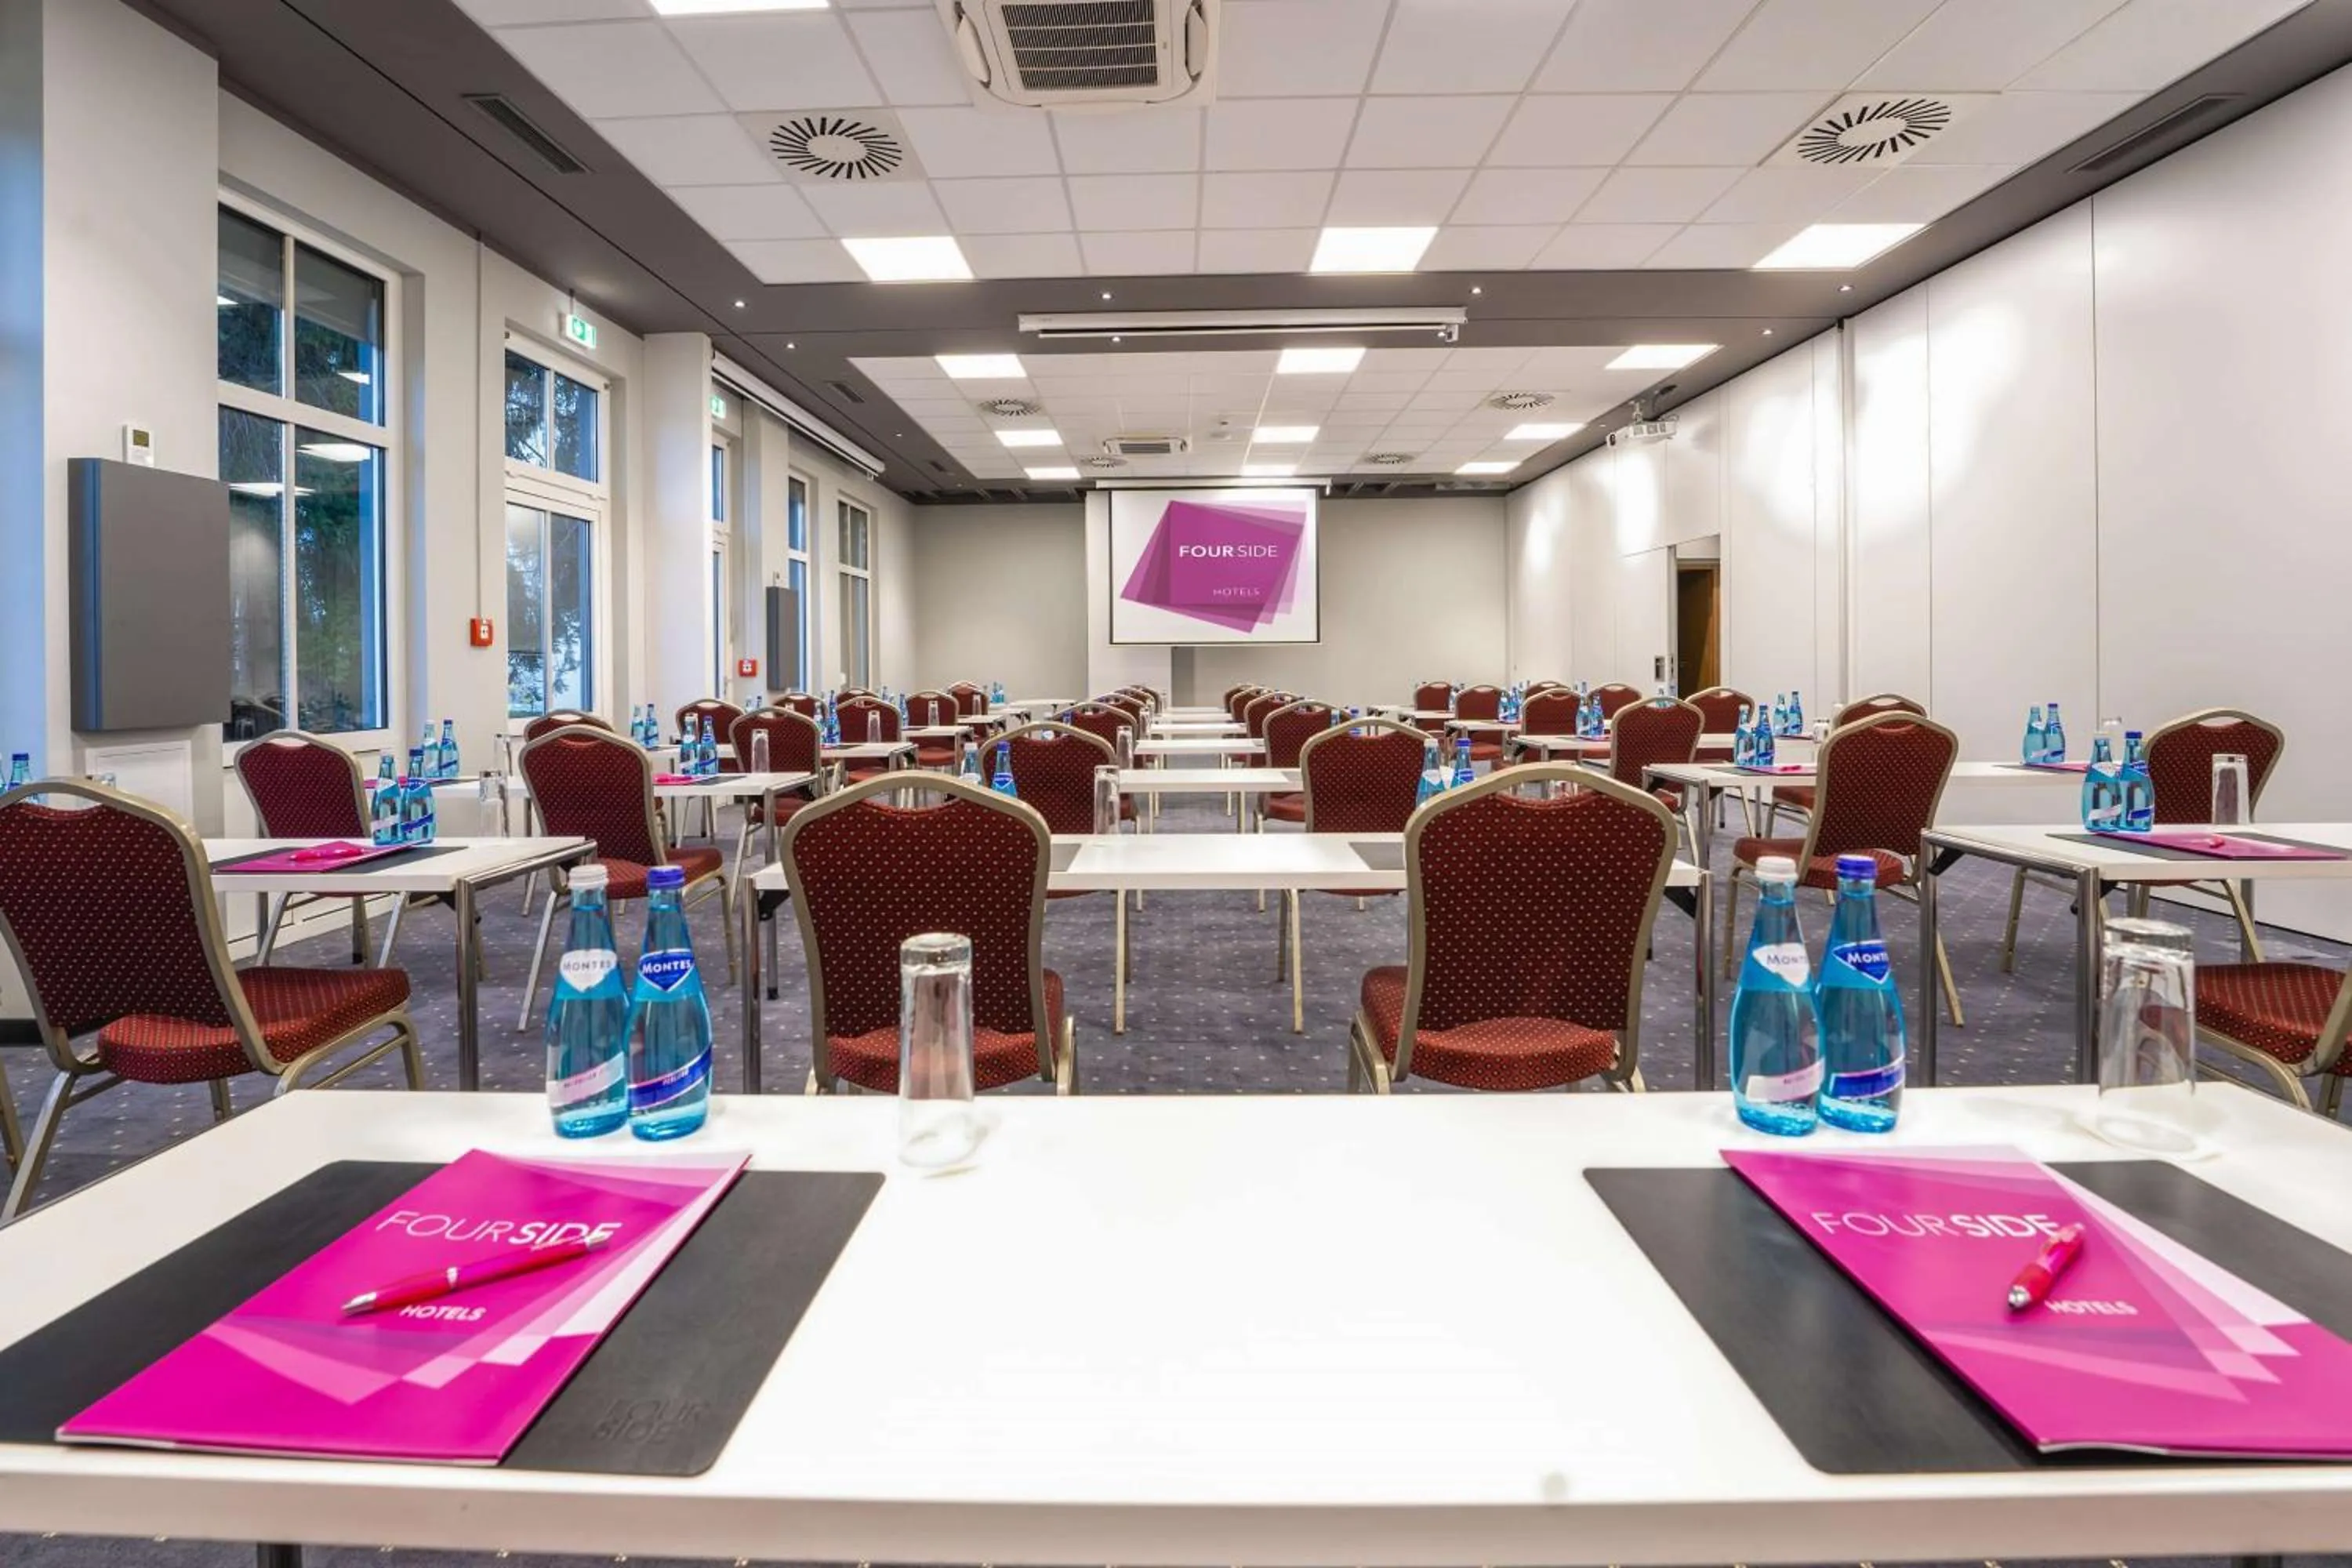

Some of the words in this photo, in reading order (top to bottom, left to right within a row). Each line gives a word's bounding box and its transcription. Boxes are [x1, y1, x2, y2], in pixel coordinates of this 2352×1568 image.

[1213, 587, 1261, 597] HOTELS
[562, 961, 612, 971] MONTES
[1766, 953, 1808, 966] MONT
[642, 959, 691, 975] MONTES
[398, 1304, 487, 1321] HOTELS
[2043, 1299, 2140, 1316] HOTELS
